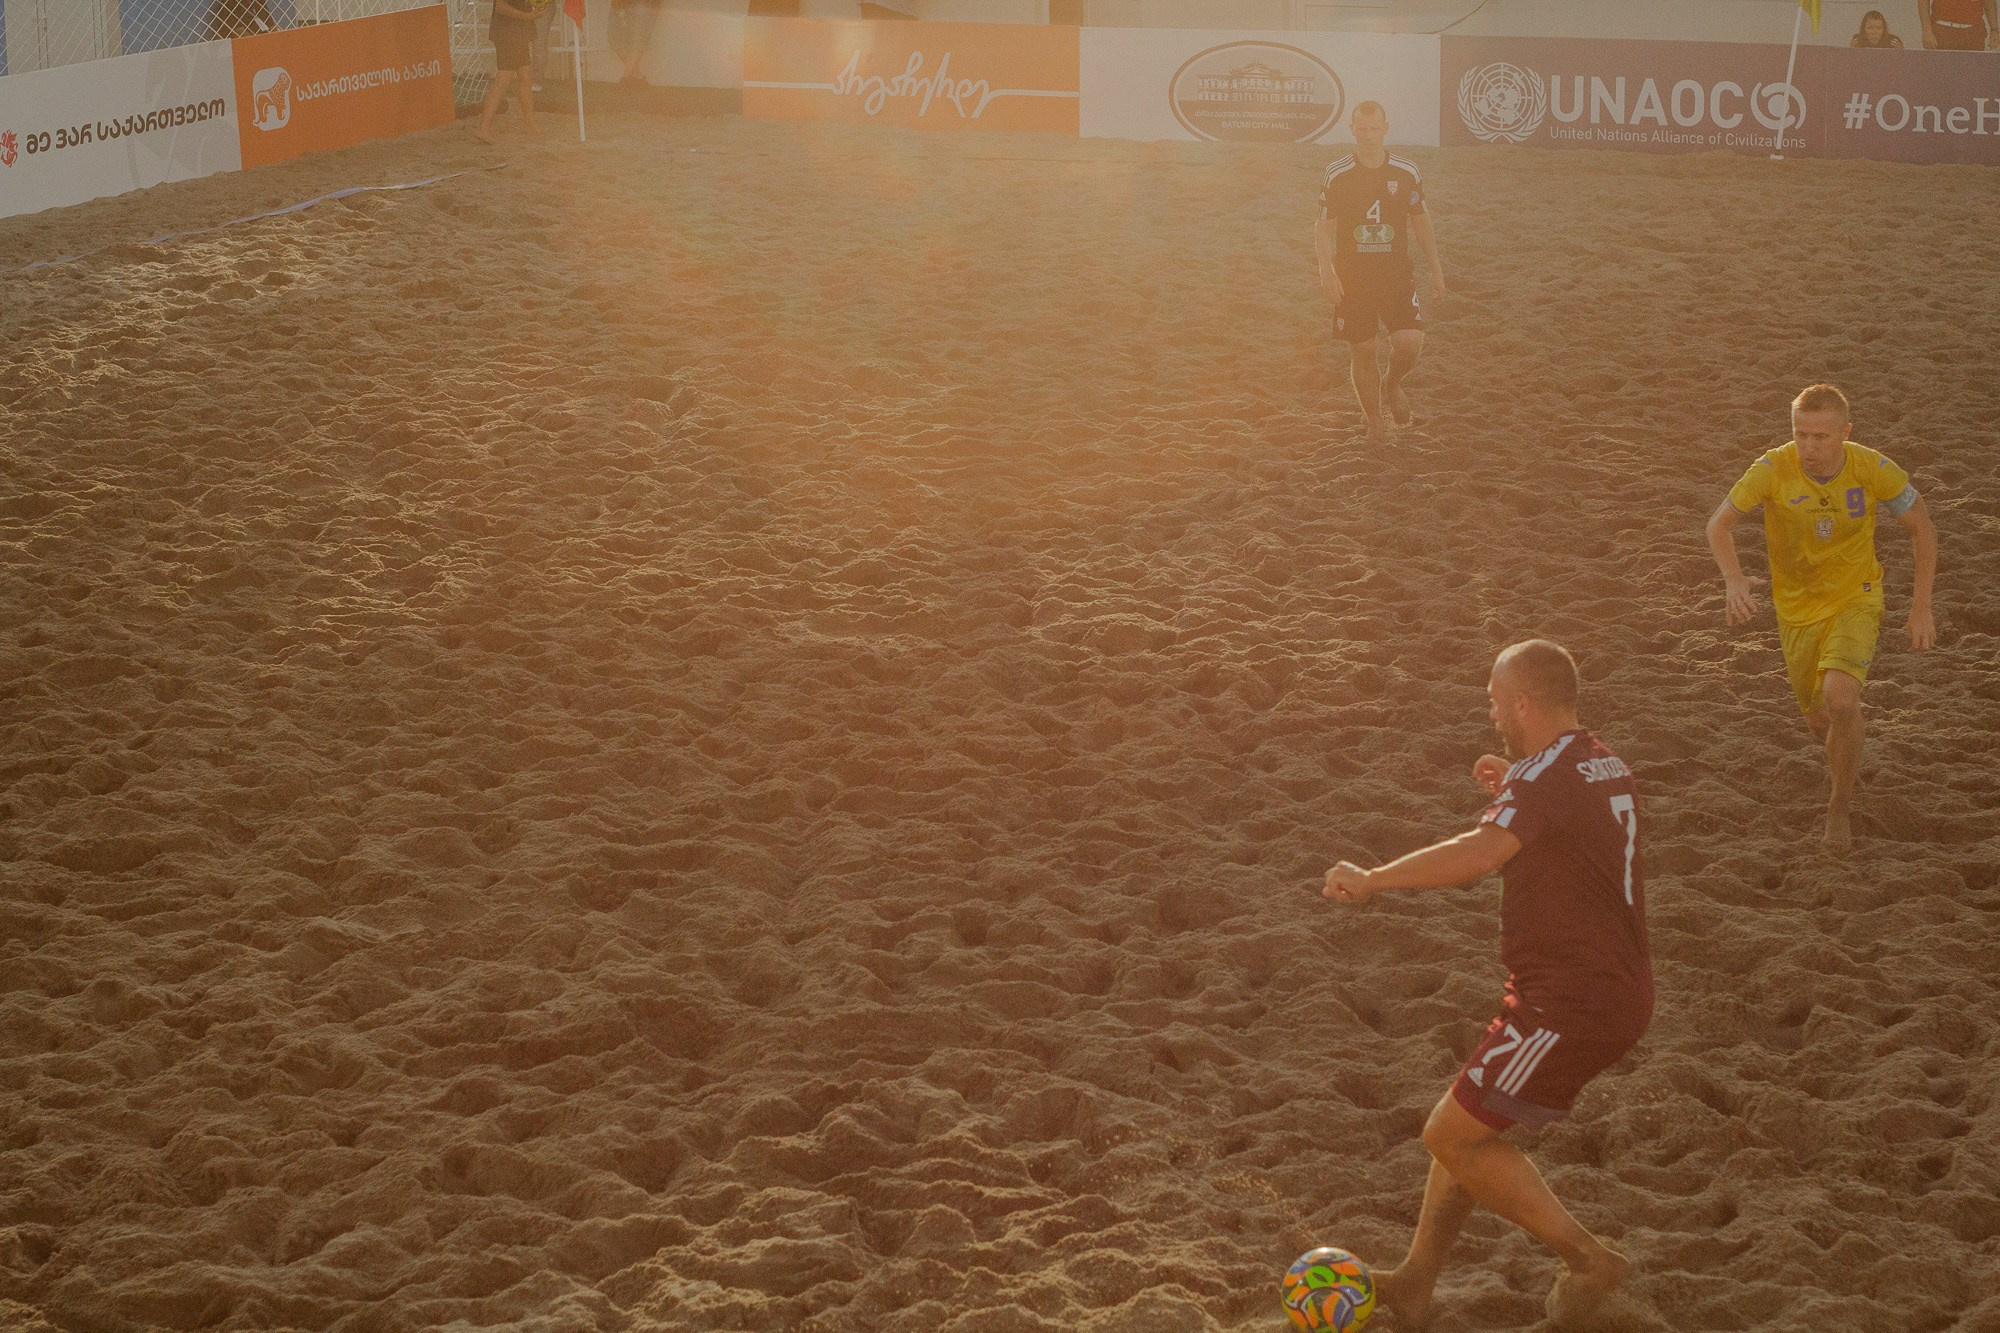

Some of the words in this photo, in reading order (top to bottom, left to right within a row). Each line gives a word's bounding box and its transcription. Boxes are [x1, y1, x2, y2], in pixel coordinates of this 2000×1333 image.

[296, 66, 401, 102] საქართველოს
[403, 59, 441, 81] ბანკი
[1550, 73, 1744, 129] UNAOC
[26, 131, 51, 154] მე
[56, 123, 92, 149] ვარ
[97, 98, 225, 141] საქართველო
[1221, 121, 1251, 129] BATUMI
[1252, 121, 1270, 129] CITY
[1271, 122, 1291, 130] HALL
[1550, 127, 1592, 140] United
[1597, 128, 1648, 143] Nations
[1651, 130, 1704, 144] Alliance
[1708, 132, 1722, 145] of
[1725, 133, 1806, 149] Civilizatons
[1366, 200, 1381, 224] 4
[1846, 486, 1866, 519] 9
[1609, 794, 1637, 905] 7
[1481, 1023, 1523, 1065] 7
